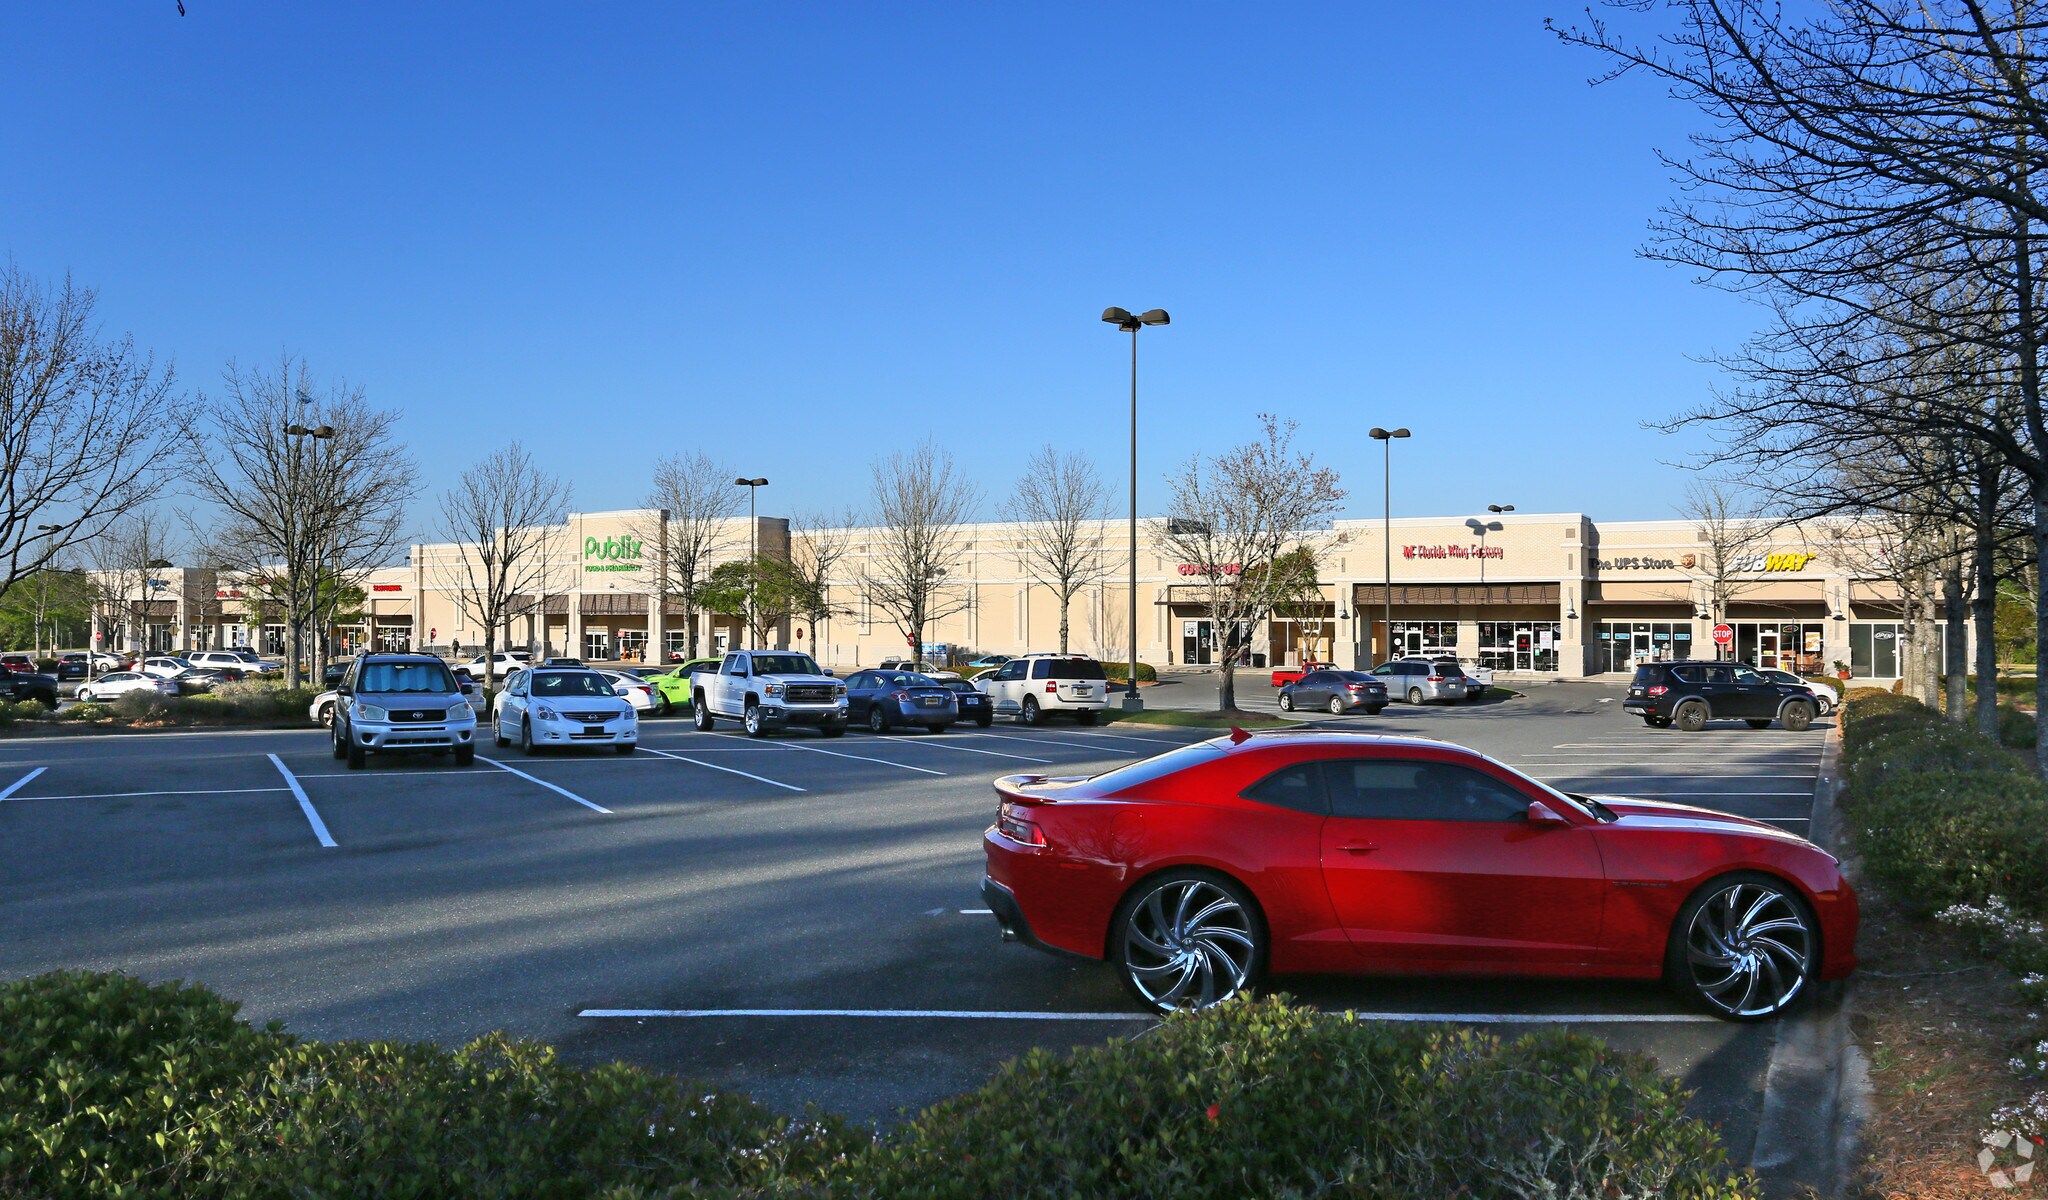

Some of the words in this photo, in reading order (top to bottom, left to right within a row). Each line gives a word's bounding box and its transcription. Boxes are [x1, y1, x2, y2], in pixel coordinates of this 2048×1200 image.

[585, 534, 642, 560] Publix
[1418, 545, 1446, 559] Florida
[1448, 544, 1468, 560] Wing
[1471, 544, 1503, 560] Factory
[1614, 557, 1640, 570] UPS
[1642, 556, 1674, 569] Store
[1724, 552, 1815, 572] SUBWAY
[1713, 630, 1731, 638] STOP
